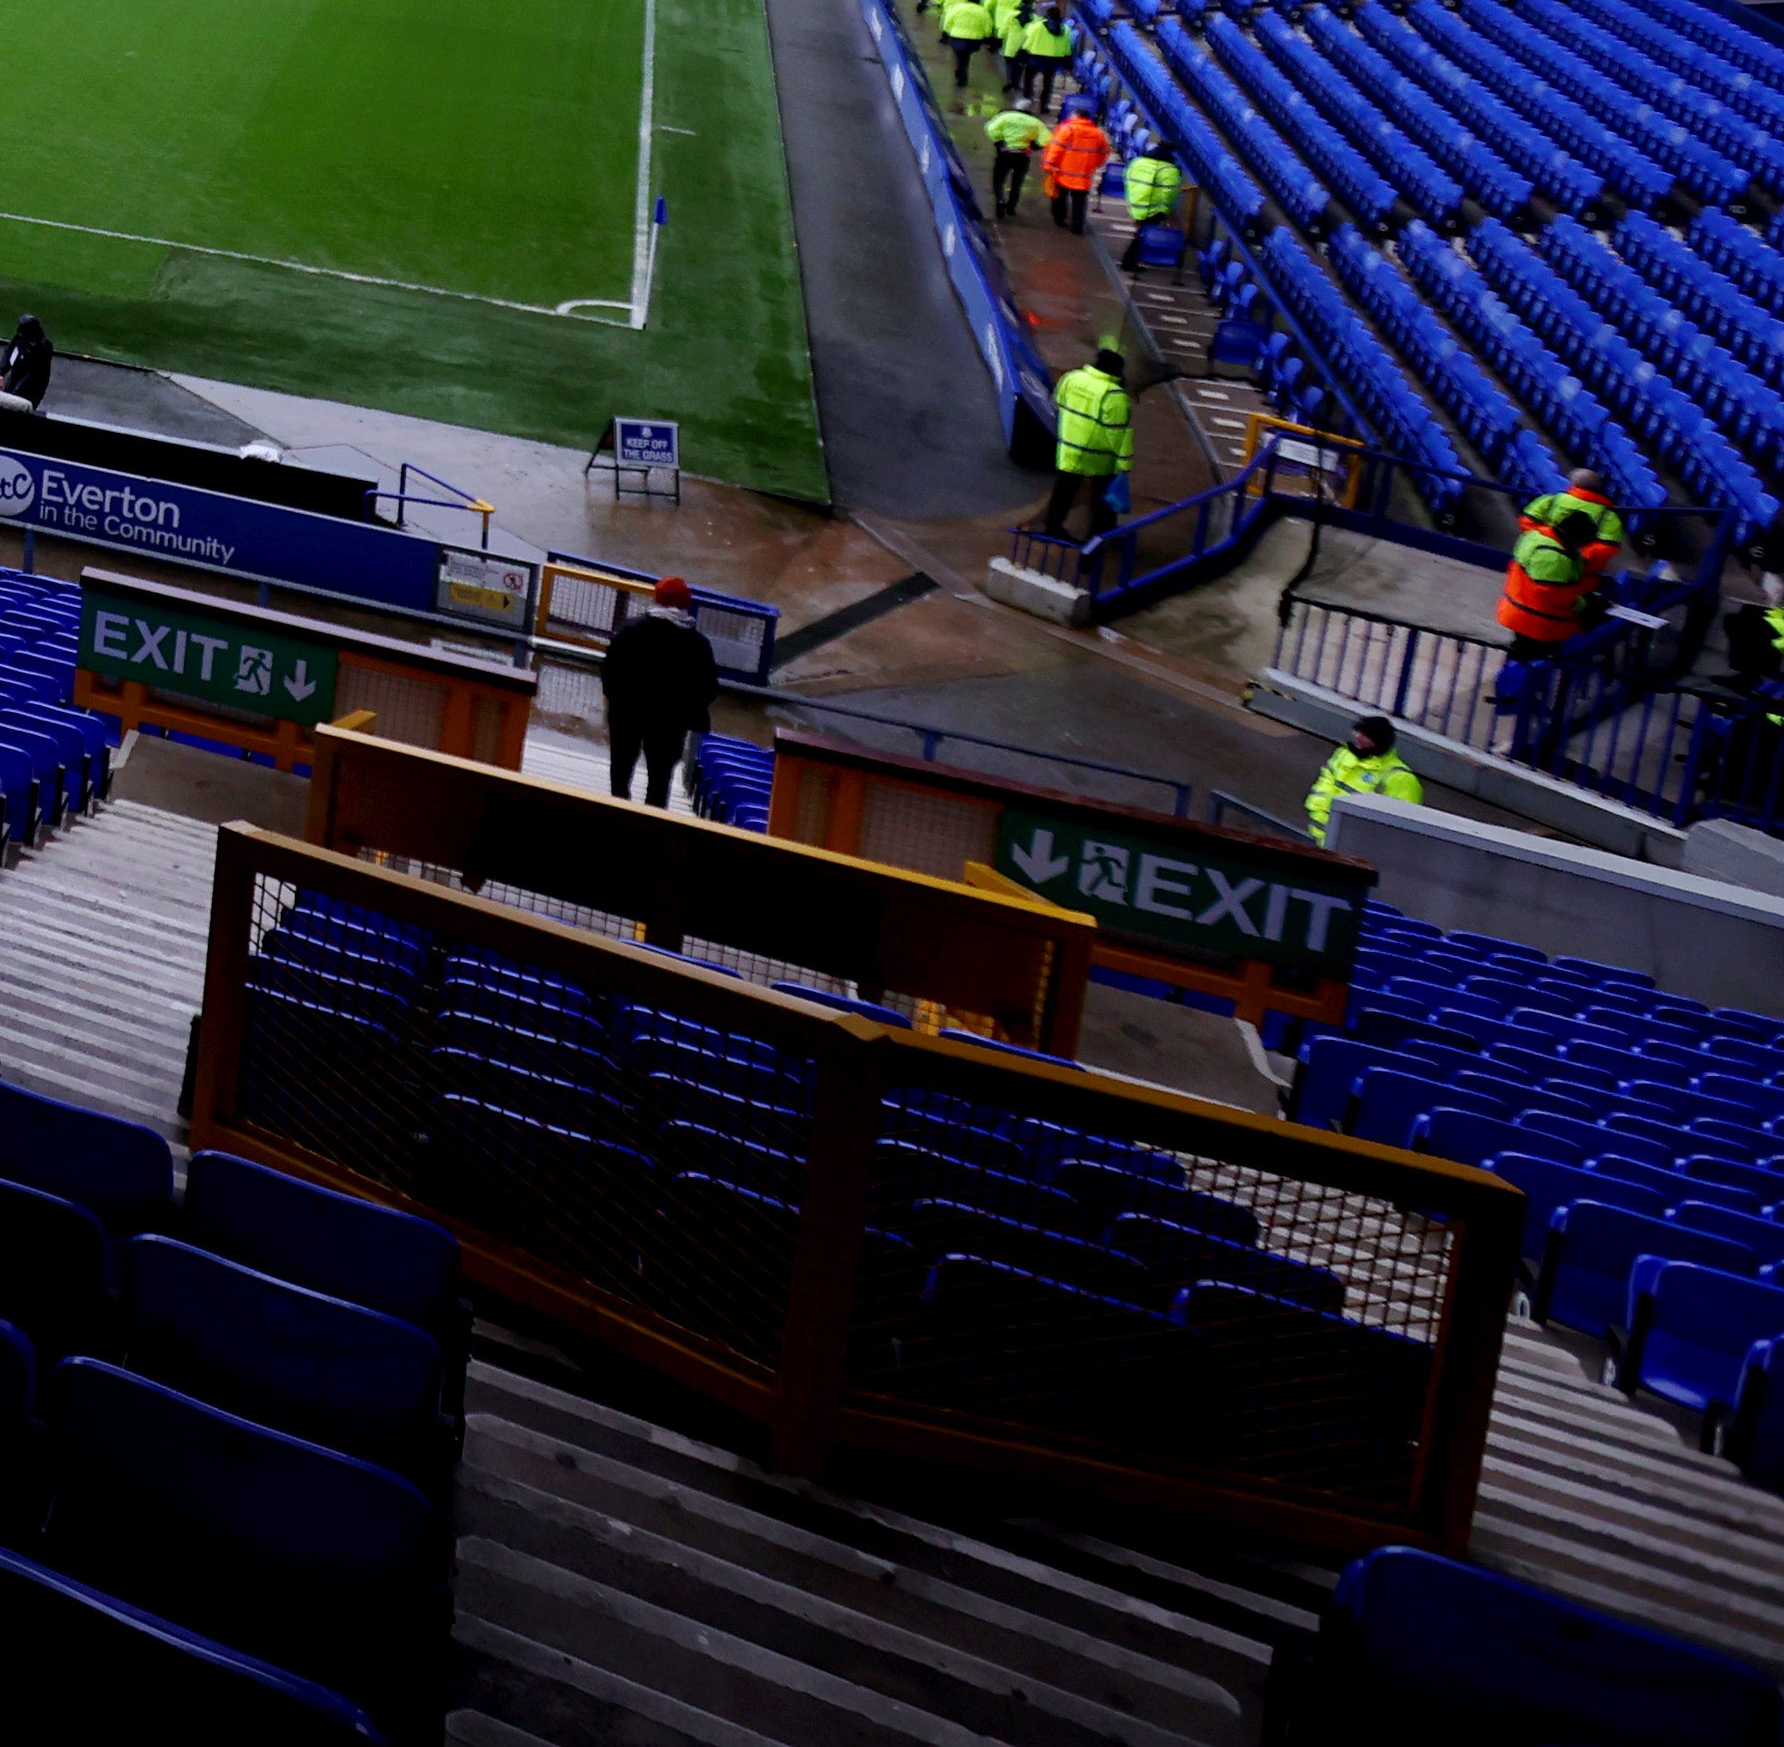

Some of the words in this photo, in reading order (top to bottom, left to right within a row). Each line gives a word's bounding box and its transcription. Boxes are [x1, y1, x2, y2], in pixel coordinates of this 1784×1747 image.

[623, 448, 641, 460] THE
[642, 450, 674, 463] GRASS
[626, 437, 650, 449] KEEP
[651, 439, 669, 450] OFF
[40, 469, 181, 529] Everton
[39, 501, 58, 522] in
[64, 508, 98, 531] the
[104, 514, 236, 566] Community
[92, 609, 230, 682] EXIT
[1134, 852, 1354, 953] EXIT
